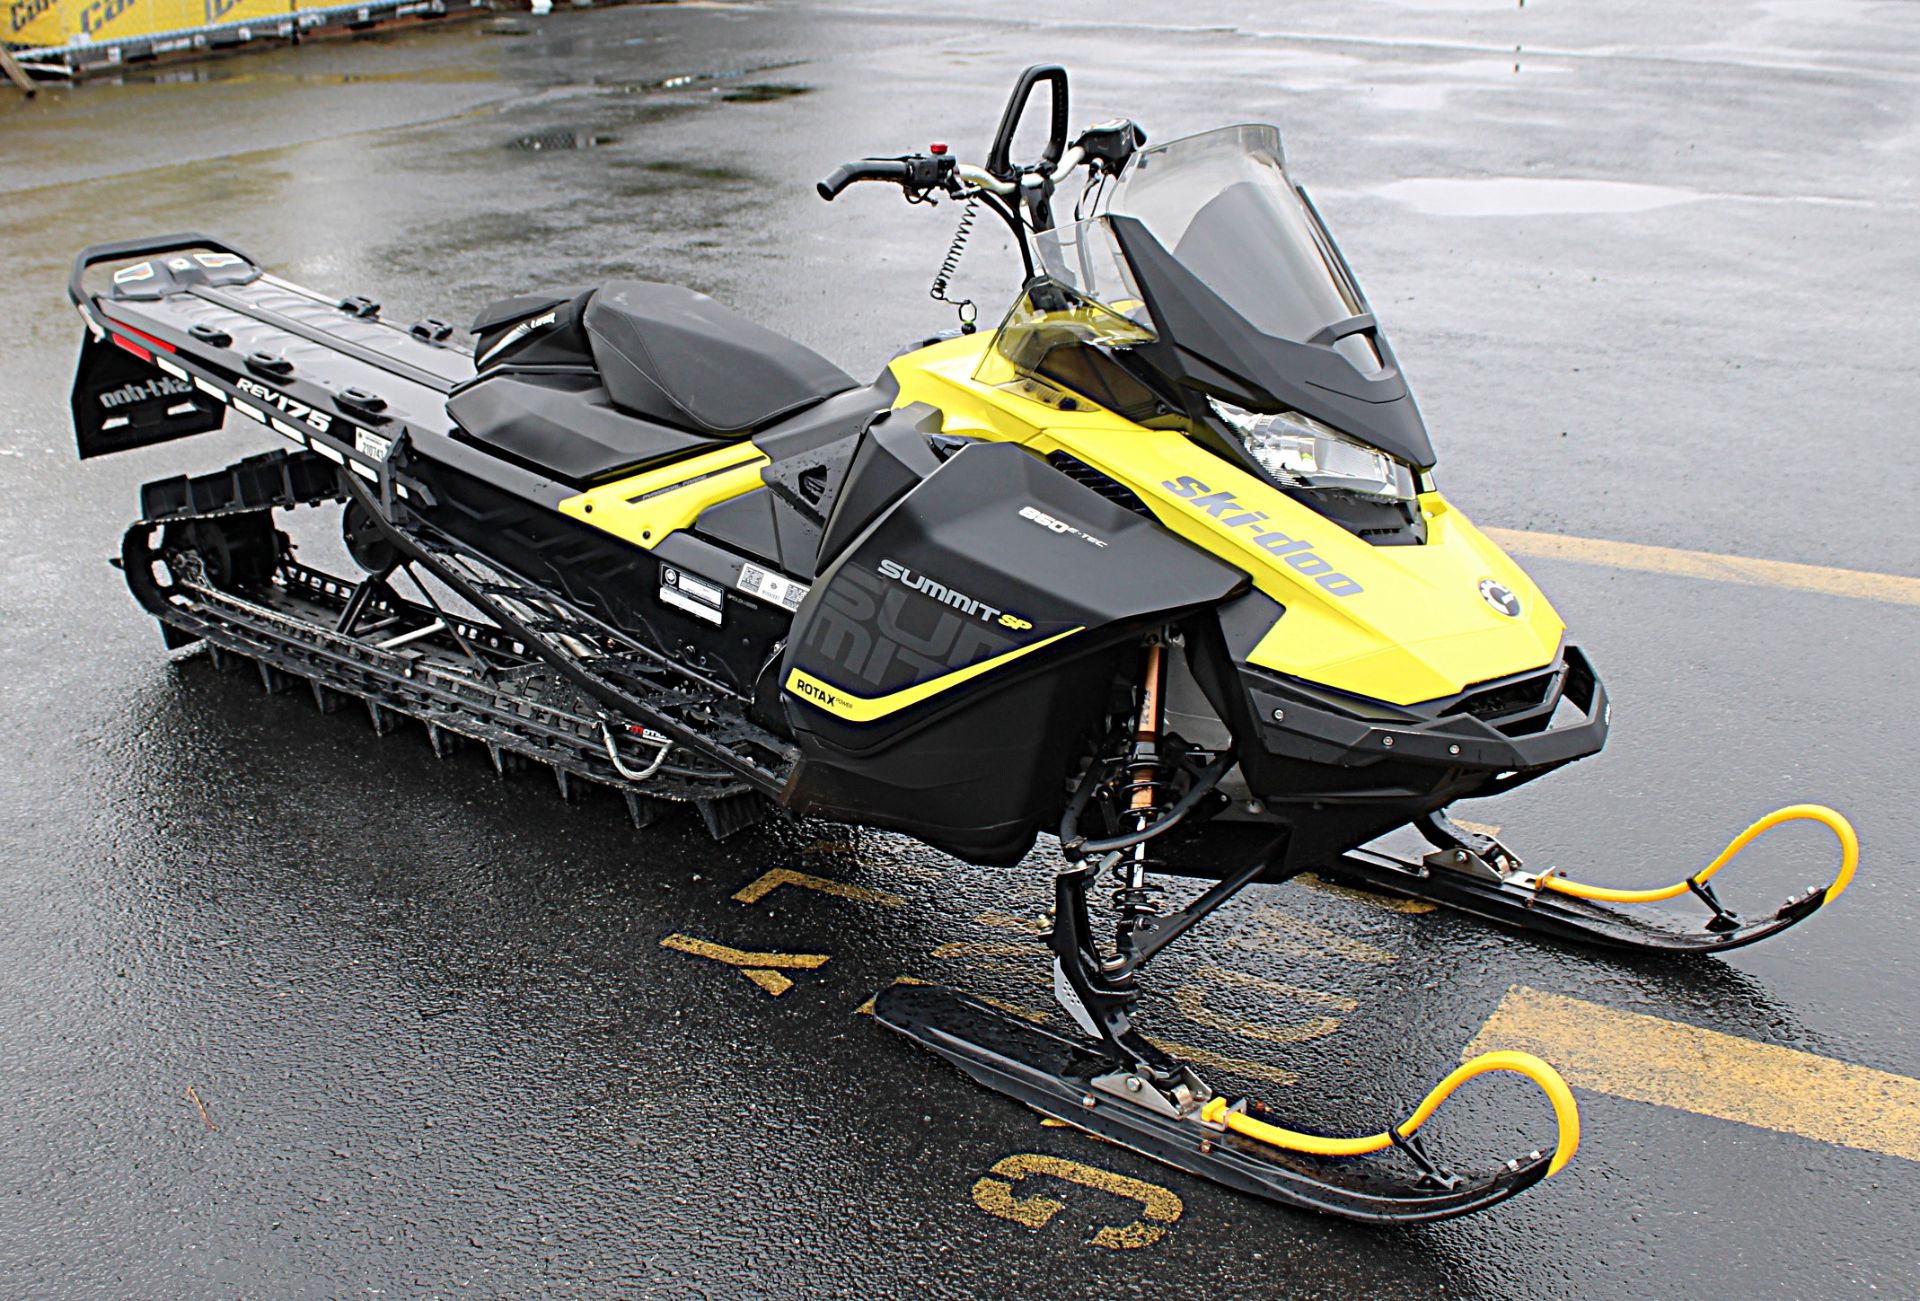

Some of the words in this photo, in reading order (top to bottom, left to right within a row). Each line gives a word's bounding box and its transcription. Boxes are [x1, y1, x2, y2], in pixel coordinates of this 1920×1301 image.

[1018, 506, 1071, 533] 850
[1161, 475, 1364, 597] ski-doo
[877, 559, 1001, 622] SUMMIT
[998, 614, 1033, 630] SP
[797, 679, 836, 707] ROTAX
